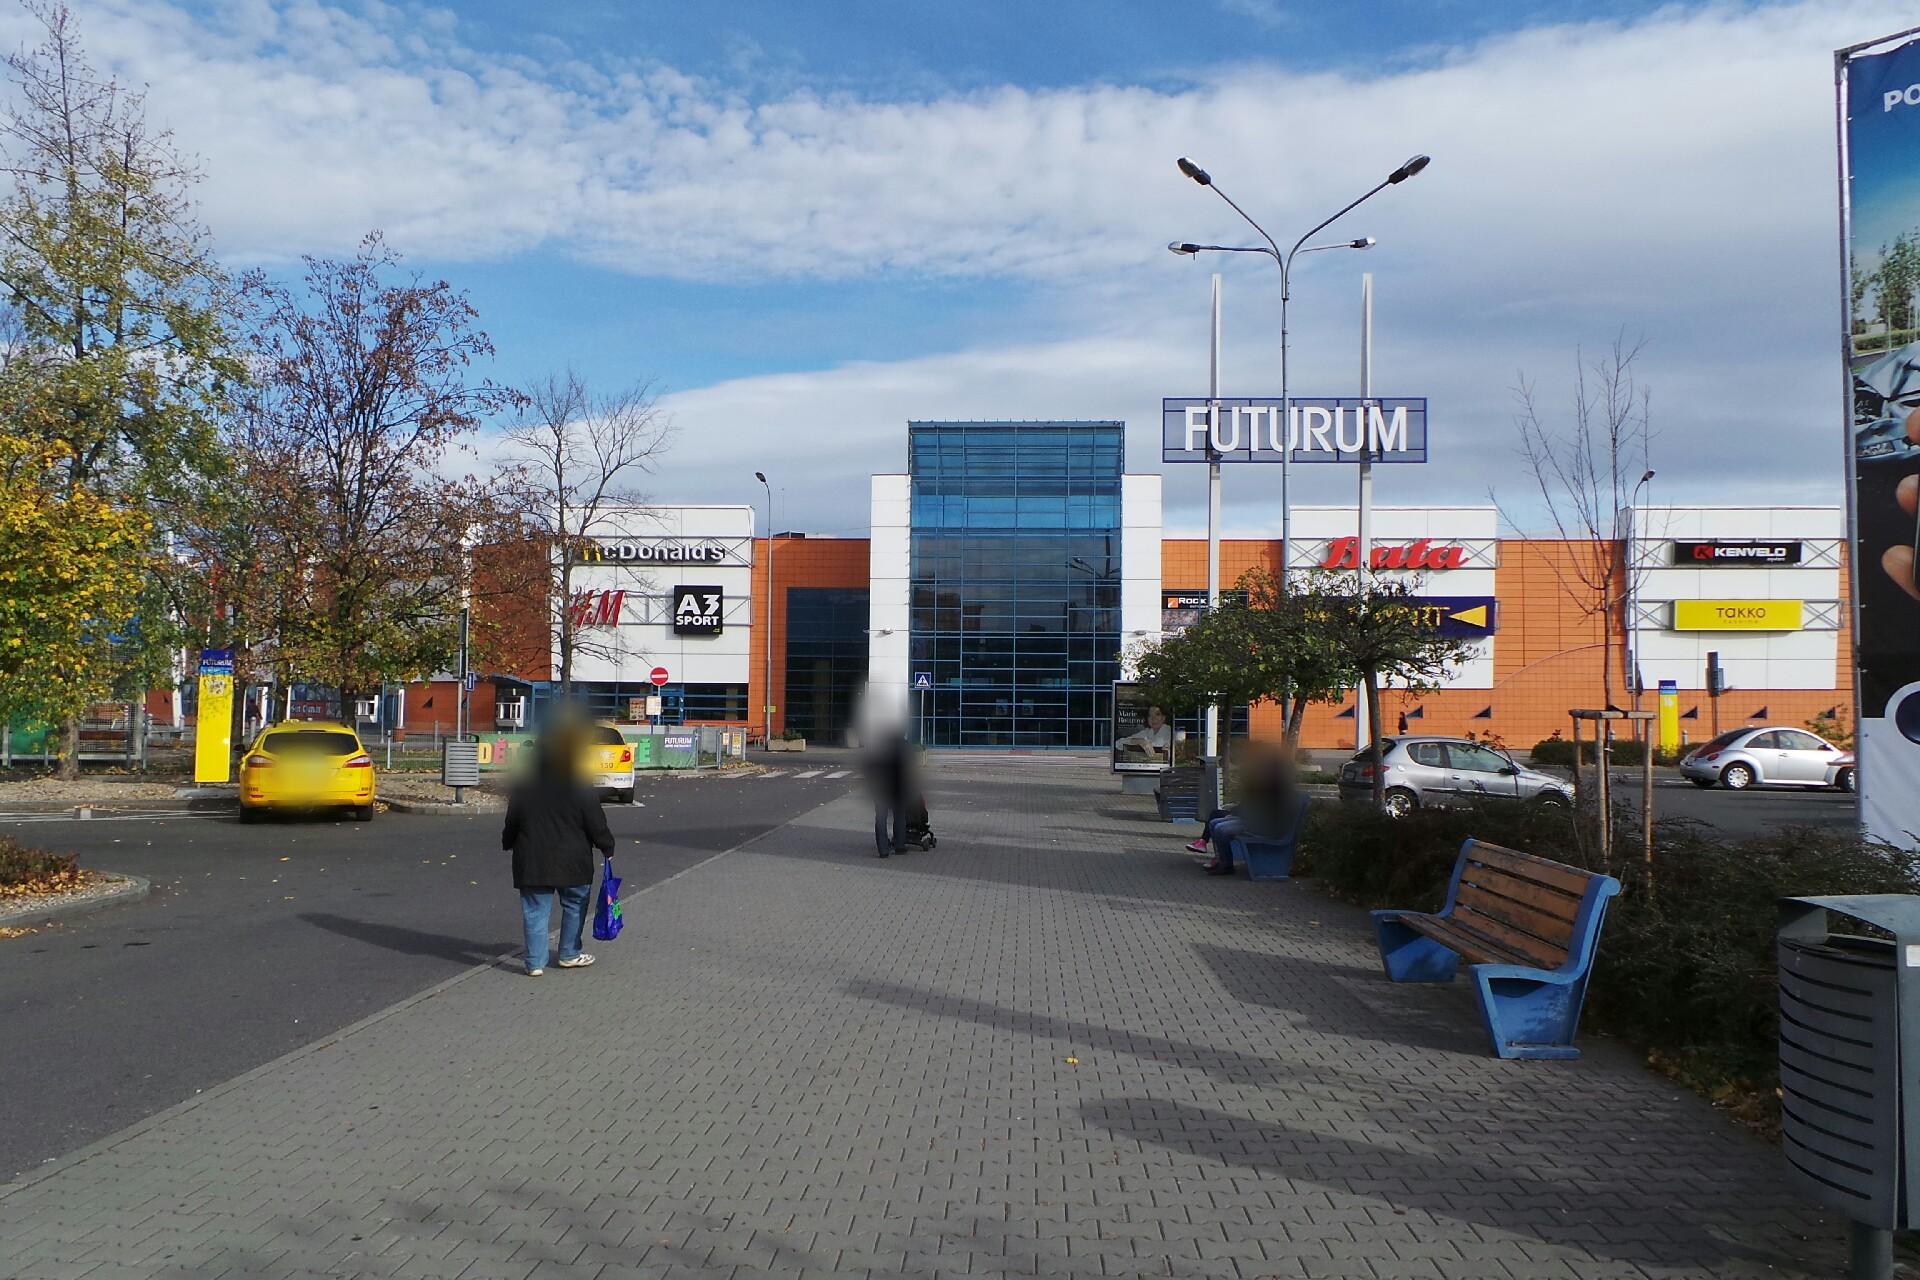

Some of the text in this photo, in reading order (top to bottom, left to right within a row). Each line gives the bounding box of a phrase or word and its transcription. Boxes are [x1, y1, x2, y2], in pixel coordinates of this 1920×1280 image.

[1184, 406, 1408, 453] FUTURUM
[1319, 536, 1470, 569] Bata
[1714, 547, 1787, 557] KENVELO
[676, 594, 721, 615] A3
[675, 616, 719, 626] SPORT
[664, 737, 692, 745] FUTURUM
